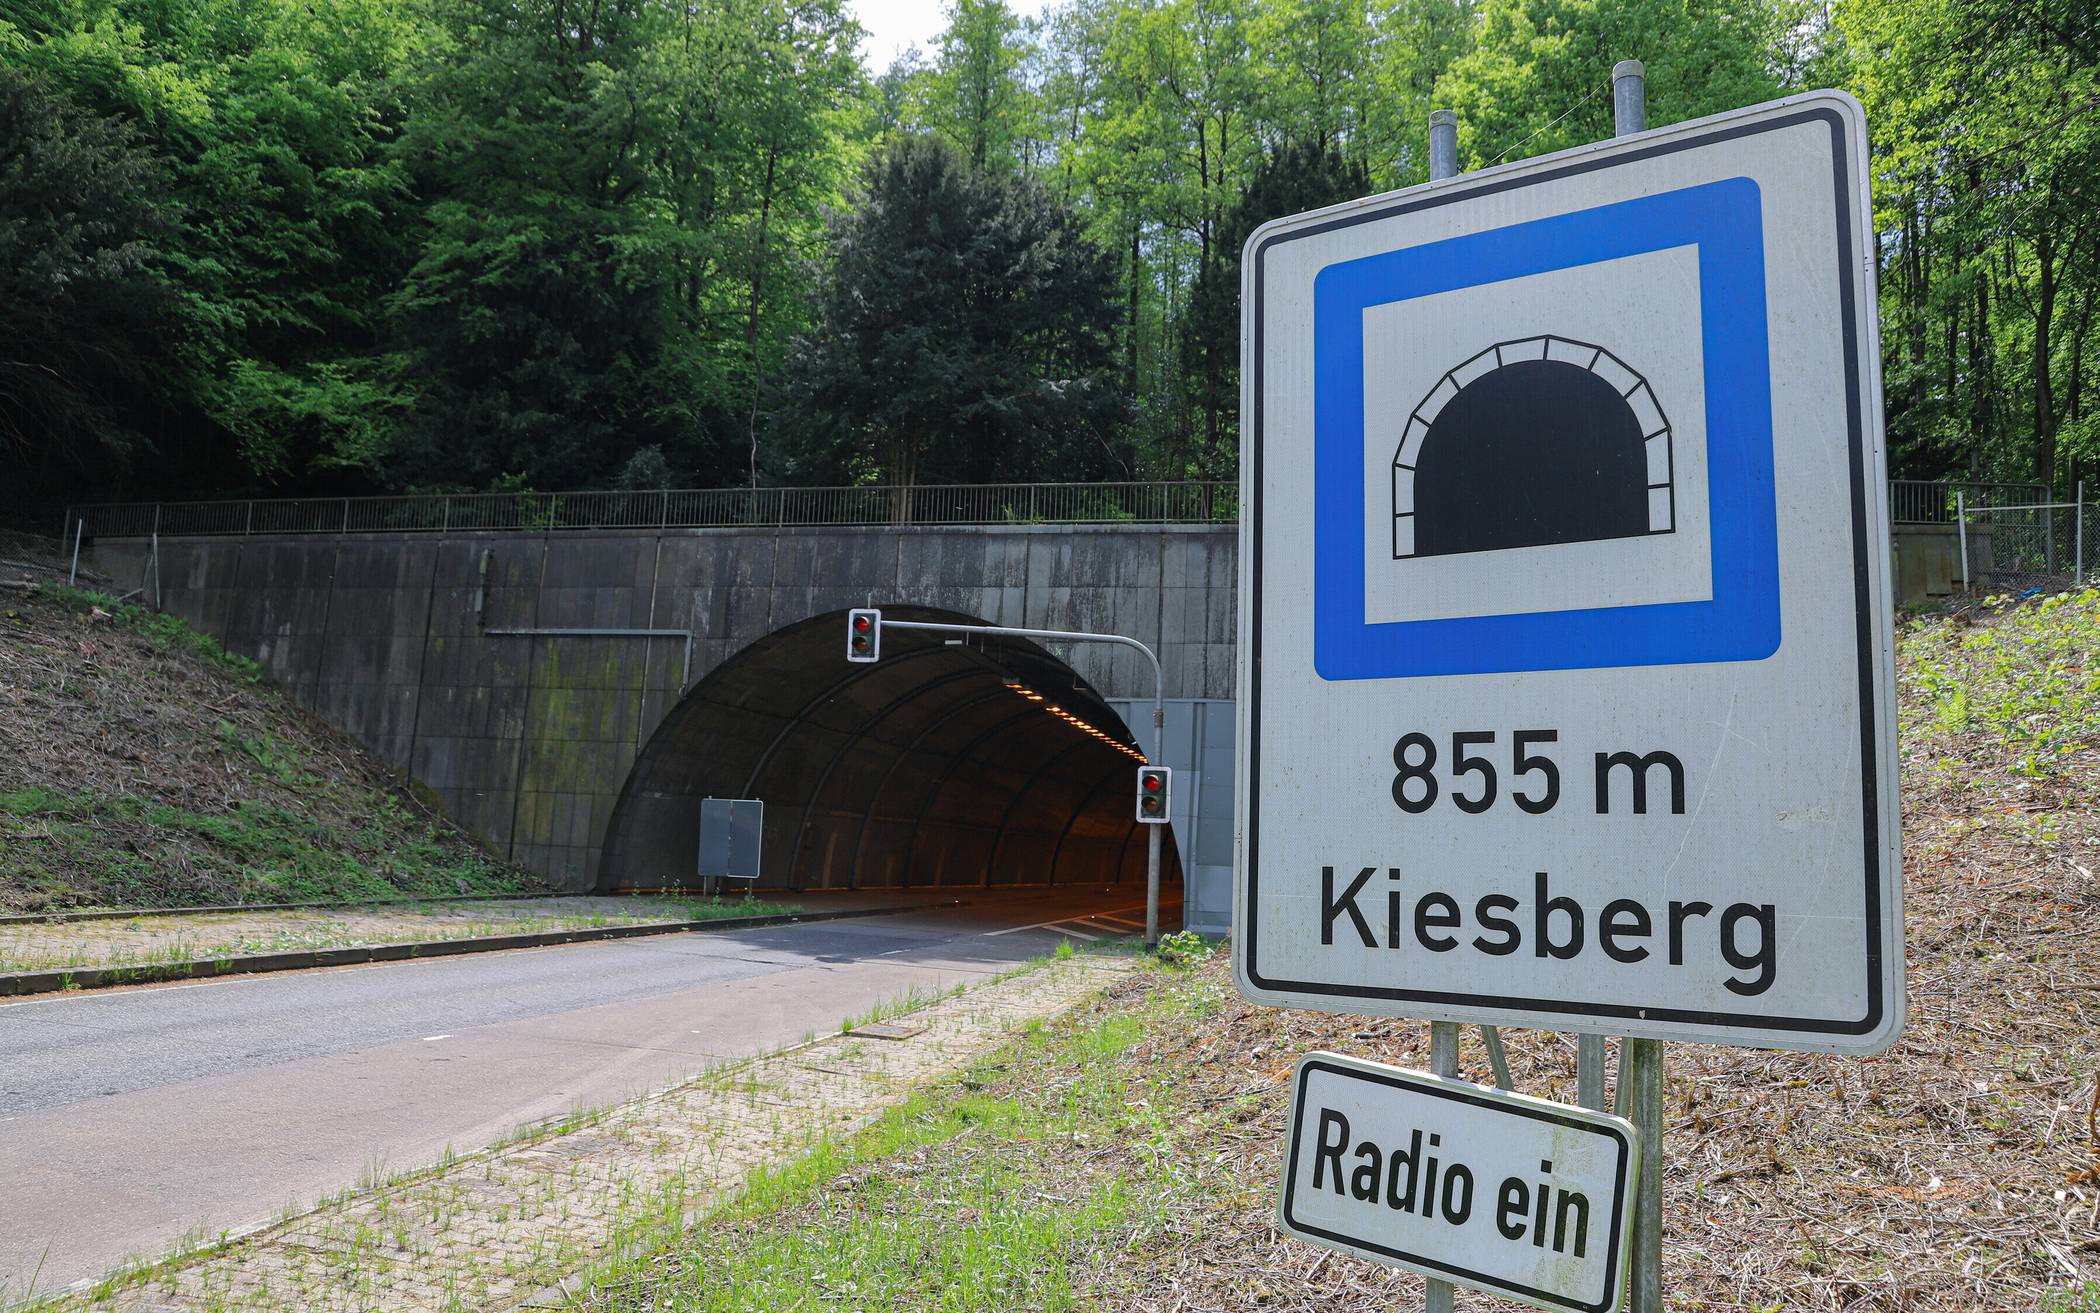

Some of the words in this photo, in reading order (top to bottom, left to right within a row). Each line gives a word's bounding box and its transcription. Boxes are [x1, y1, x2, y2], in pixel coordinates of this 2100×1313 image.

[1391, 730, 1560, 815] 855
[1594, 750, 1686, 815] m
[1320, 866, 1777, 997] Kiesberg
[1312, 1107, 1474, 1226] Radio
[1496, 1159, 1590, 1259] ein
